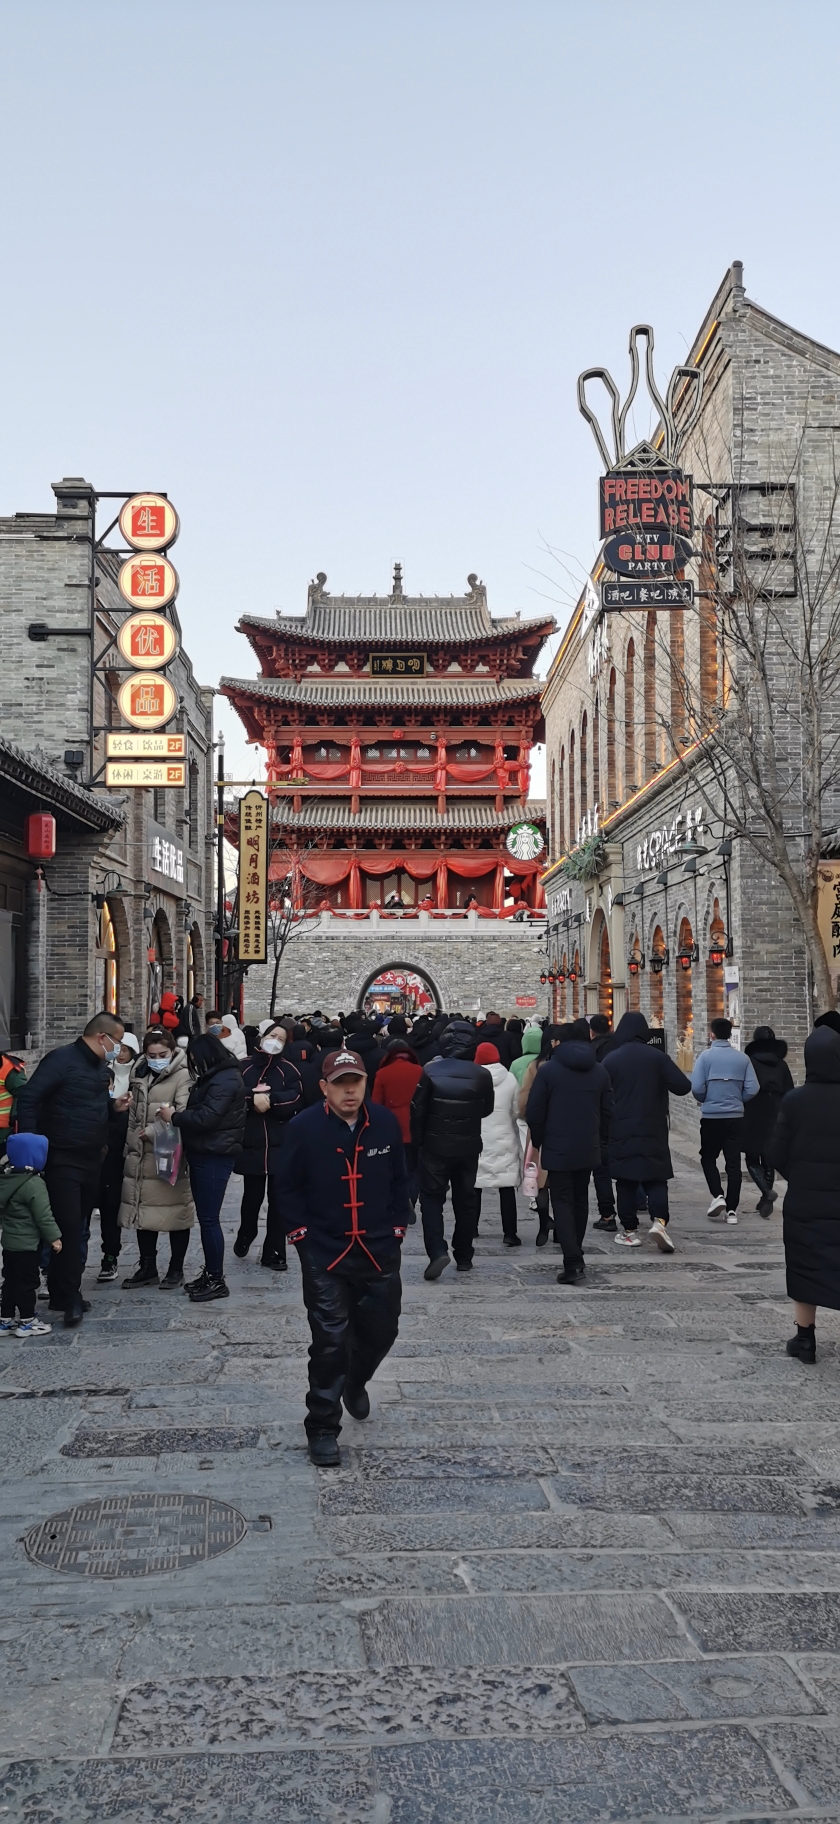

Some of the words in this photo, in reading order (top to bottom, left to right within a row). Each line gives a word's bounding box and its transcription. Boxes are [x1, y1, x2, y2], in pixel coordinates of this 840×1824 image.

[604, 479, 690, 502] FREEDOM
[604, 502, 690, 532] RELEASE
[636, 533, 660, 543] KTV
[618, 544, 676, 560] CLUB
[627, 561, 667, 571] PARTY
[607, 589, 633, 602] 酒吧
[639, 588, 664, 602] 餐吧
[112, 739, 134, 752] 轻食
[142, 739, 164, 752] 饮品
[169, 741, 182, 750] 2F
[112, 768, 133, 781] 休闲
[142, 768, 164, 781] 桌游
[169, 770, 182, 779] 2F
[151, 836, 185, 884] 生活优品
[245, 834, 261, 905] 明月酒坊
